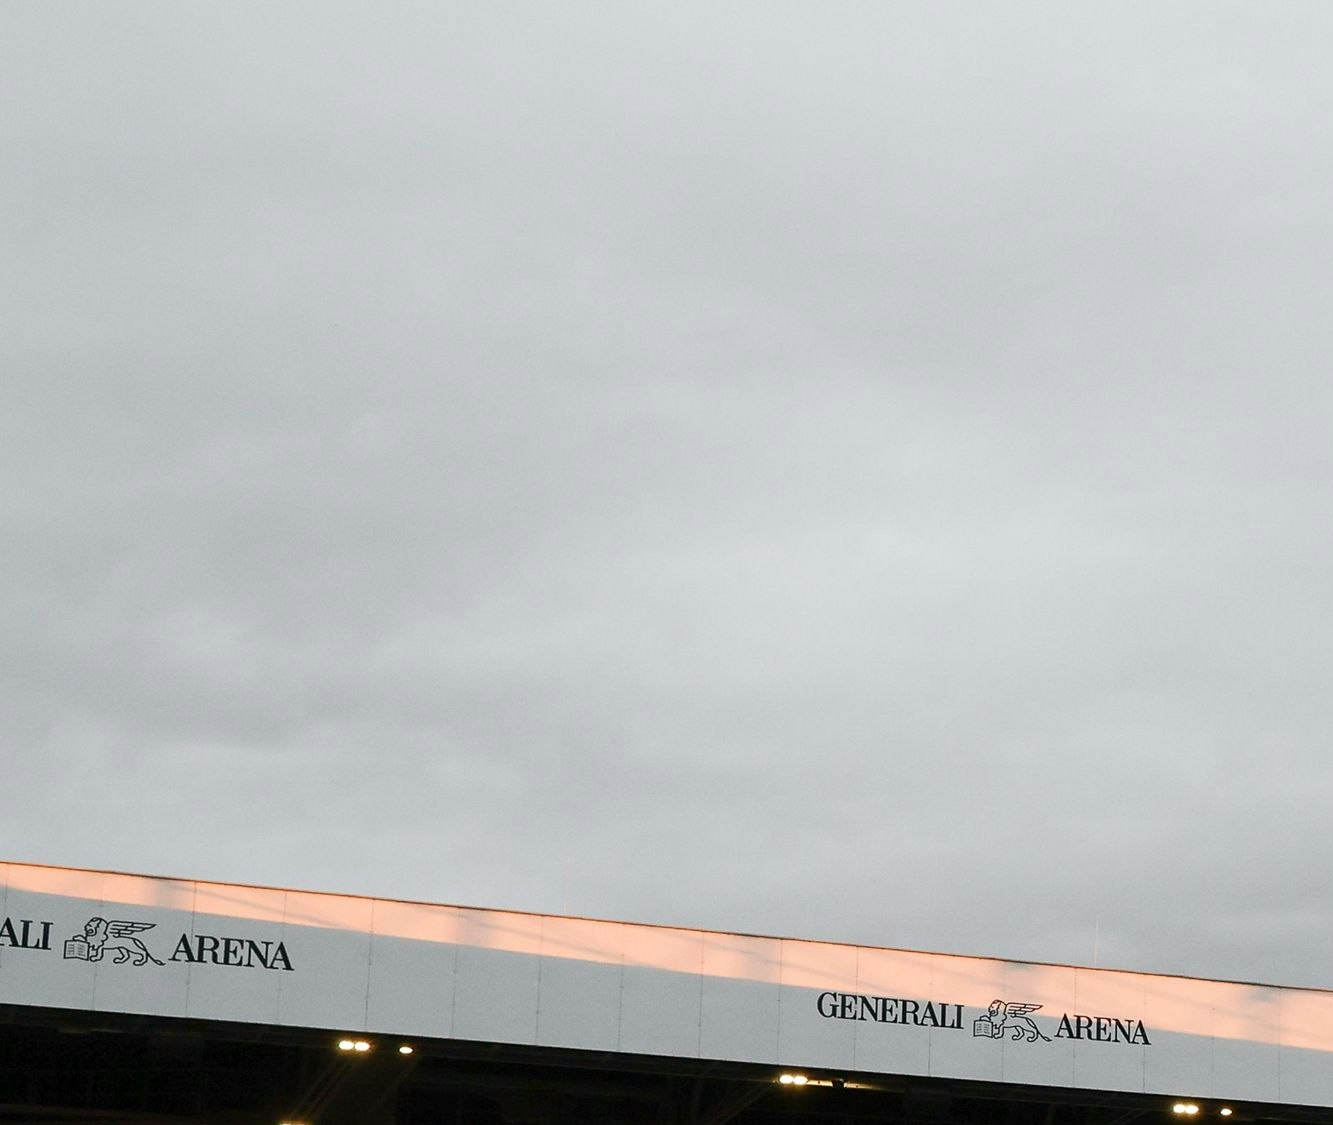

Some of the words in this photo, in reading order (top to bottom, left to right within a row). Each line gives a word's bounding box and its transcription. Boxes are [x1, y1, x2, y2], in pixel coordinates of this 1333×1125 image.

[168, 933, 295, 971] ARENA
[816, 991, 965, 1030] GENERALI
[1054, 1013, 1152, 1046] ARENA
